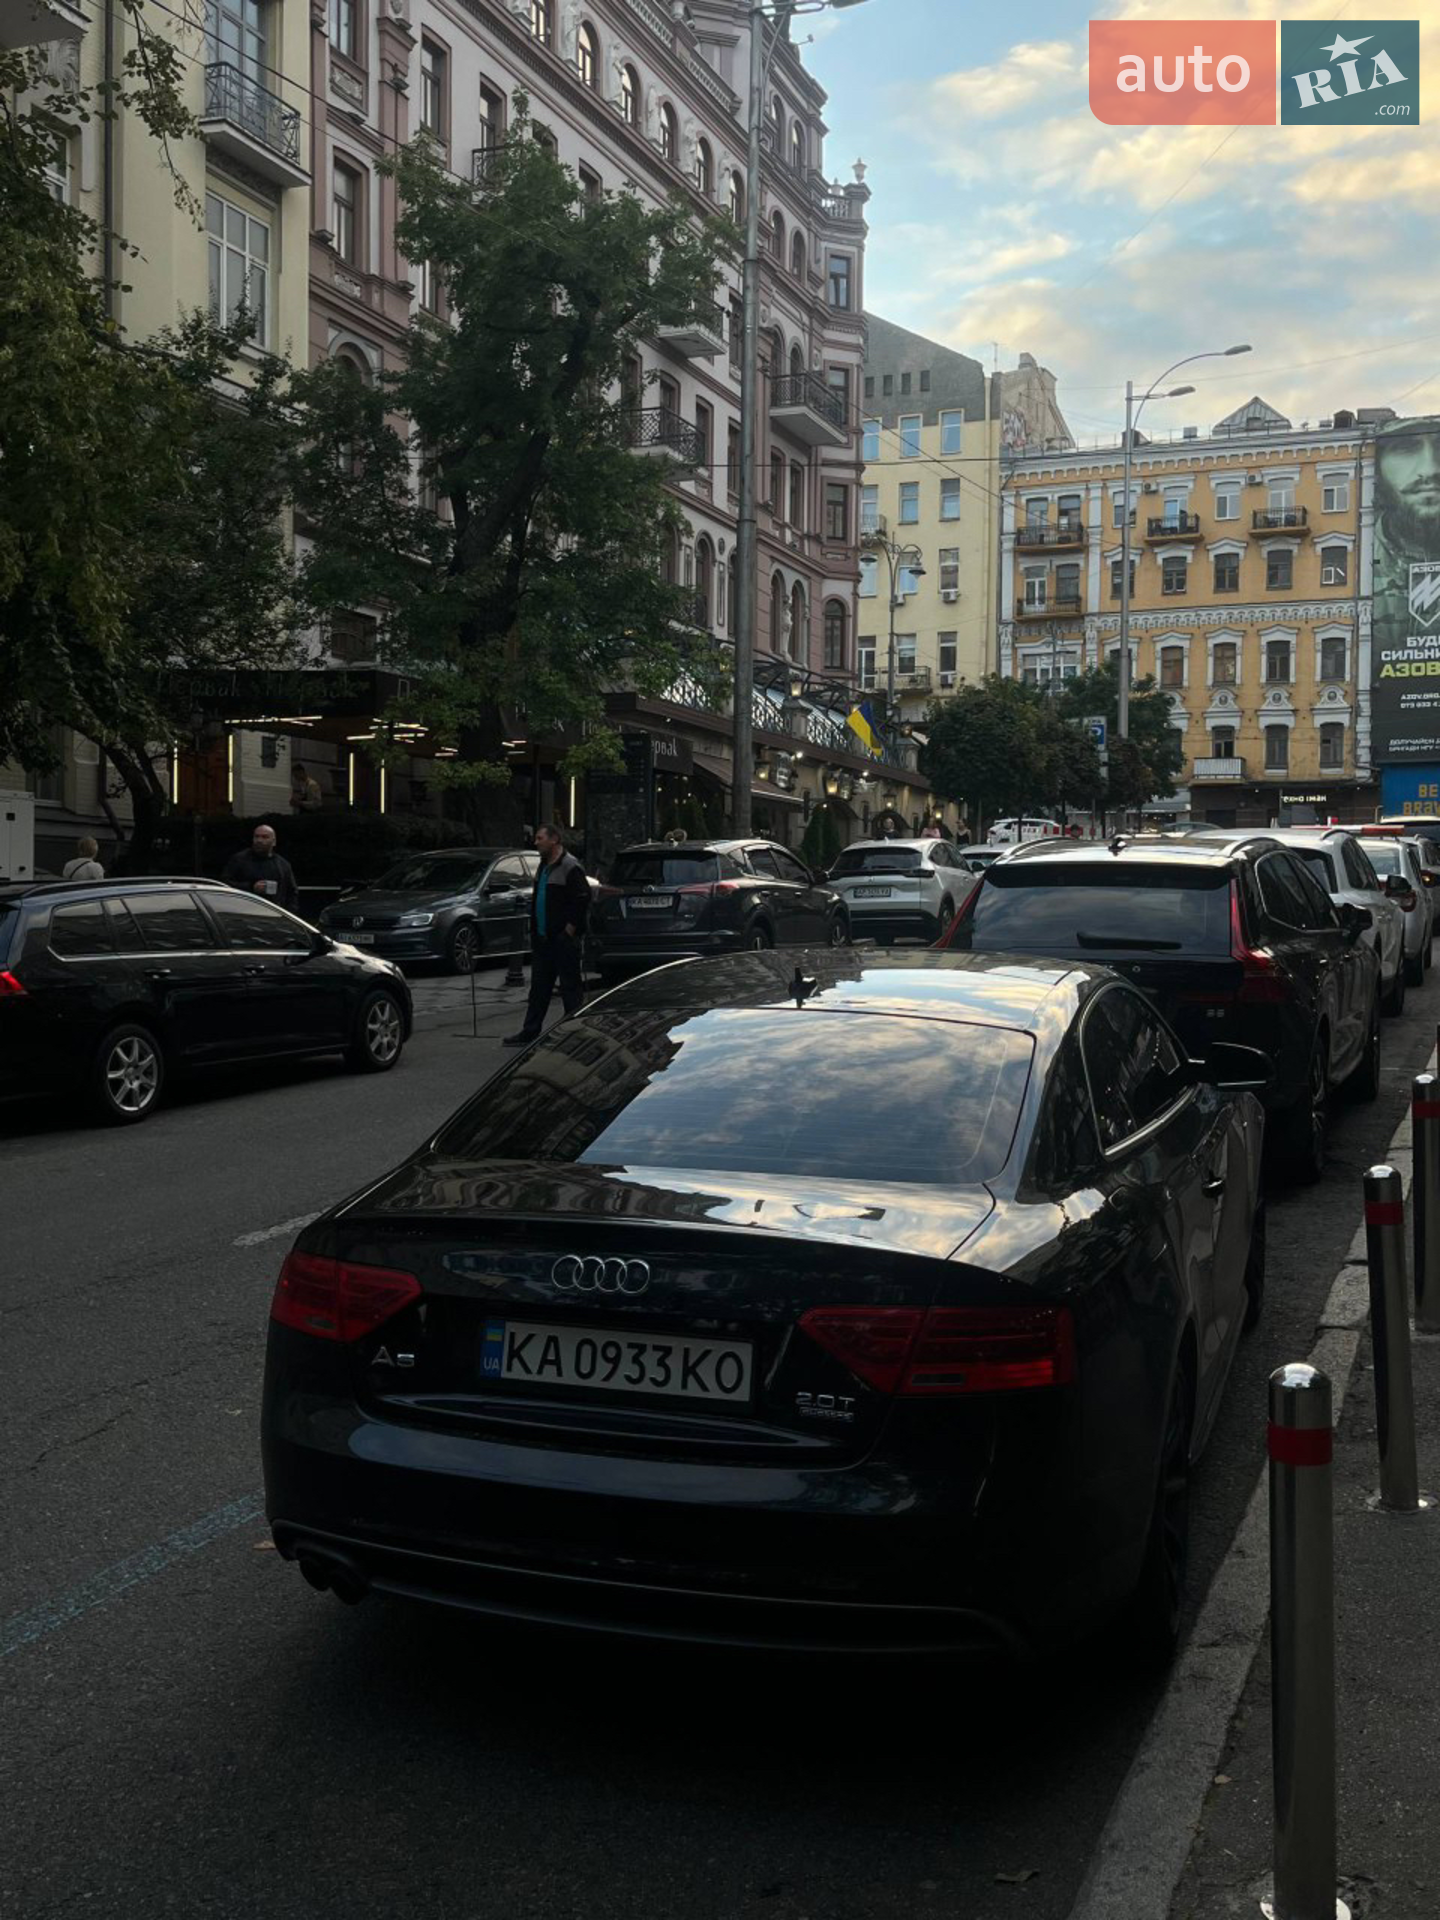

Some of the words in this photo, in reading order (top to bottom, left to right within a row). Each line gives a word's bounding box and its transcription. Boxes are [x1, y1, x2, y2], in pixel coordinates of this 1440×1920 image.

[1407, 635, 1440, 648] БУД
[371, 1345, 415, 1369] A5
[484, 1356, 501, 1371] UA
[795, 1391, 856, 1411] 2.0T
